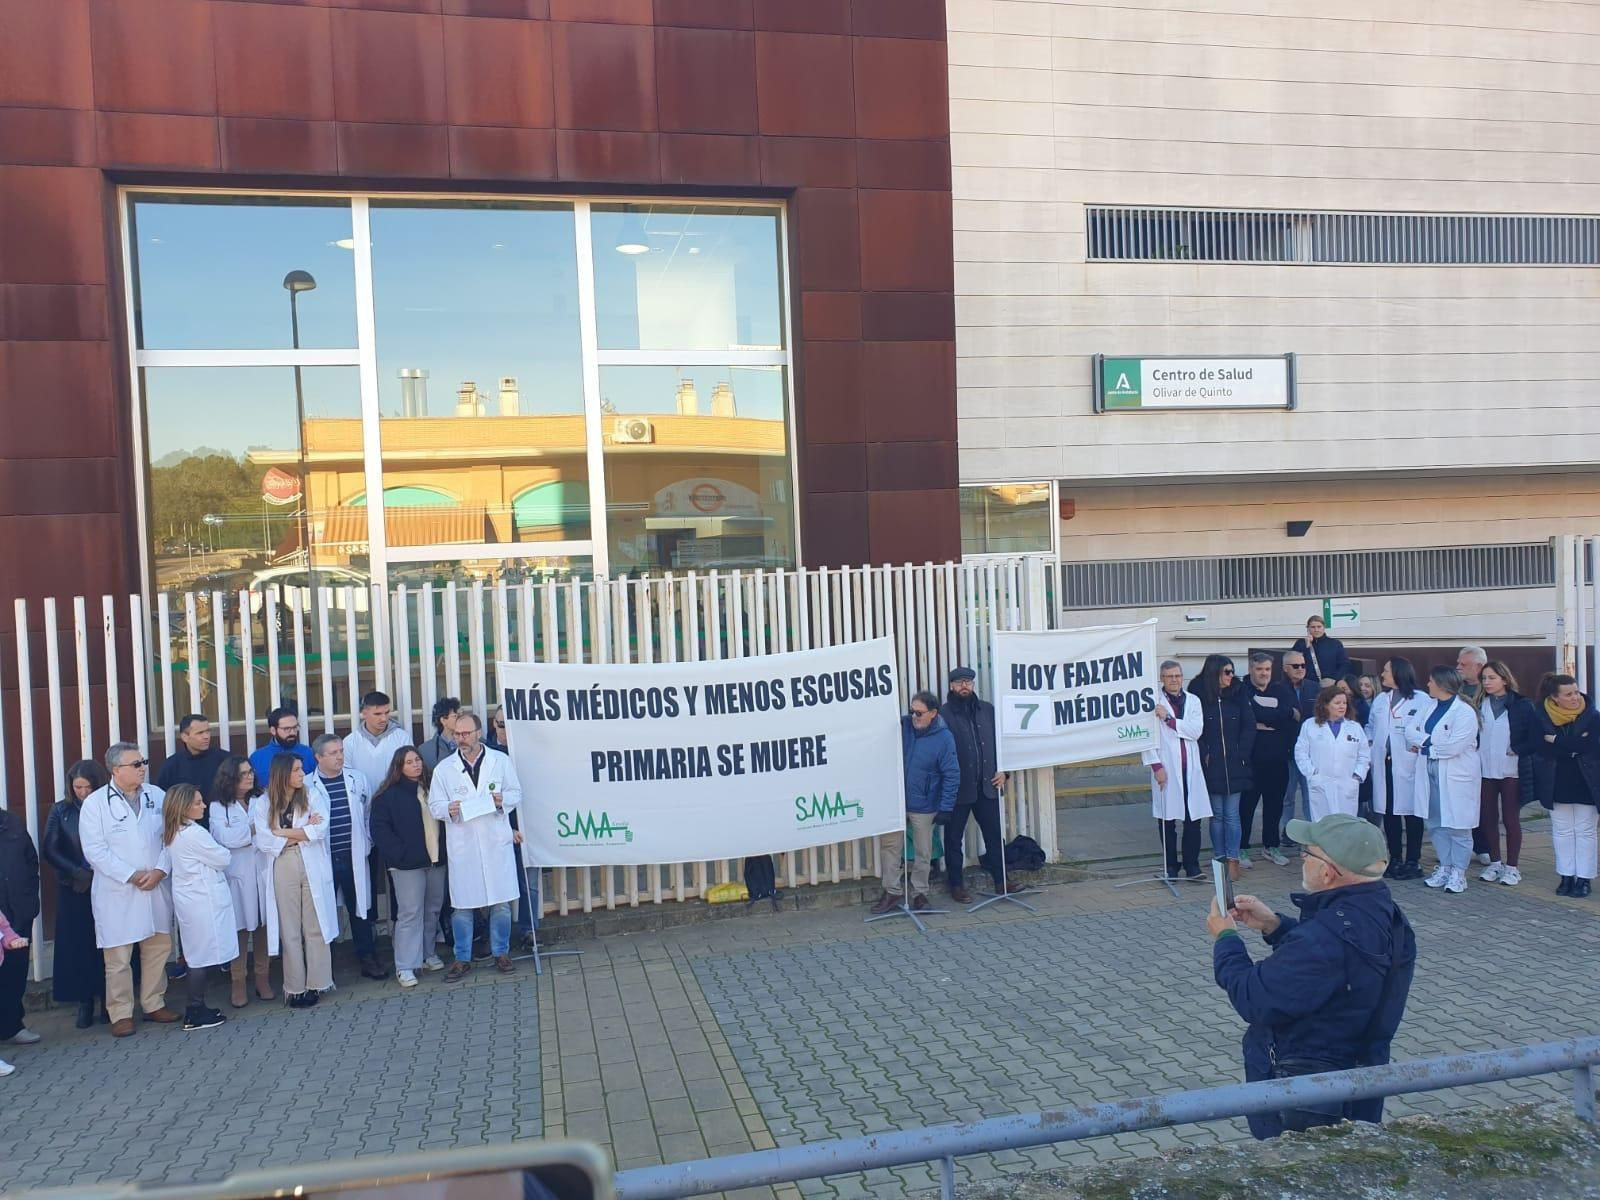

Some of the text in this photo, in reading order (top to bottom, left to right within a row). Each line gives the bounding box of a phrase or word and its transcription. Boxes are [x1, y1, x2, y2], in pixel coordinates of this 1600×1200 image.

[1152, 368, 1253, 381] Centro de Salud
[1152, 387, 1182, 398] Olivar
[1185, 387, 1197, 397] de
[1199, 386, 1233, 398] Quinto
[1010, 651, 1143, 691] HOY FALTAN
[504, 664, 893, 721] MÁS MÉDICOS Y MENOS ESCUSAS
[1014, 687, 1156, 730] 7 MÉDICOS
[591, 734, 828, 783] PRIMARIA SE MUERE
[557, 808, 613, 841] SMA
[795, 791, 846, 822] SMA
